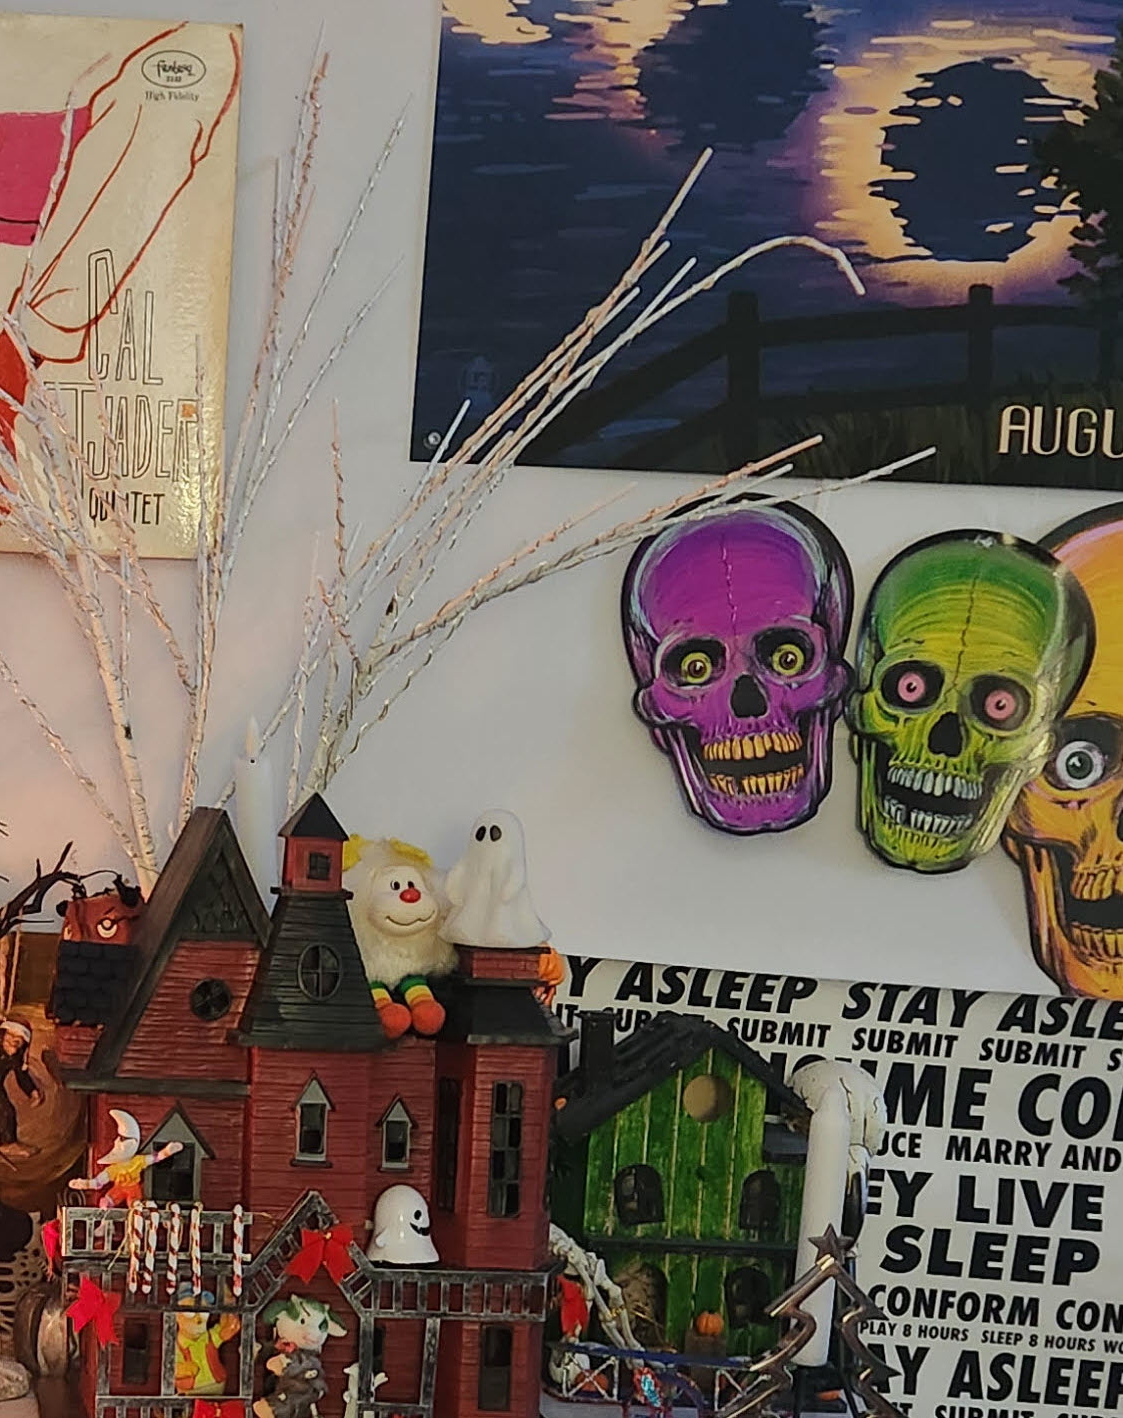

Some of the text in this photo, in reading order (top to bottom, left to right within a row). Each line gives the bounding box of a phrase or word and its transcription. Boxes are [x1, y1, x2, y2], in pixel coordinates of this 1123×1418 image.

[88, 248, 163, 386] CAL
[615, 961, 818, 1014] ASLEEP
[841, 981, 986, 1029] STAY
[851, 1027, 958, 1059] SUBMIT
[979, 1037, 1087, 1069] SUBMIT
[945, 1135, 1052, 1168] MARRY
[1060, 1144, 1121, 1173] AND
[956, 1175, 1105, 1232] LIVE
[879, 1225, 1101, 1286] SLEEP
[867, 1284, 1040, 1328] CONFORM
[859, 1320, 898, 1338] PLAY
[902, 1324, 912, 1338] 8
[918, 1325, 970, 1343] HOURS
[981, 1330, 1024, 1347] SLEEP
[1028, 1334, 1038, 1348] 8
[1044, 1335, 1096, 1352] HOURS
